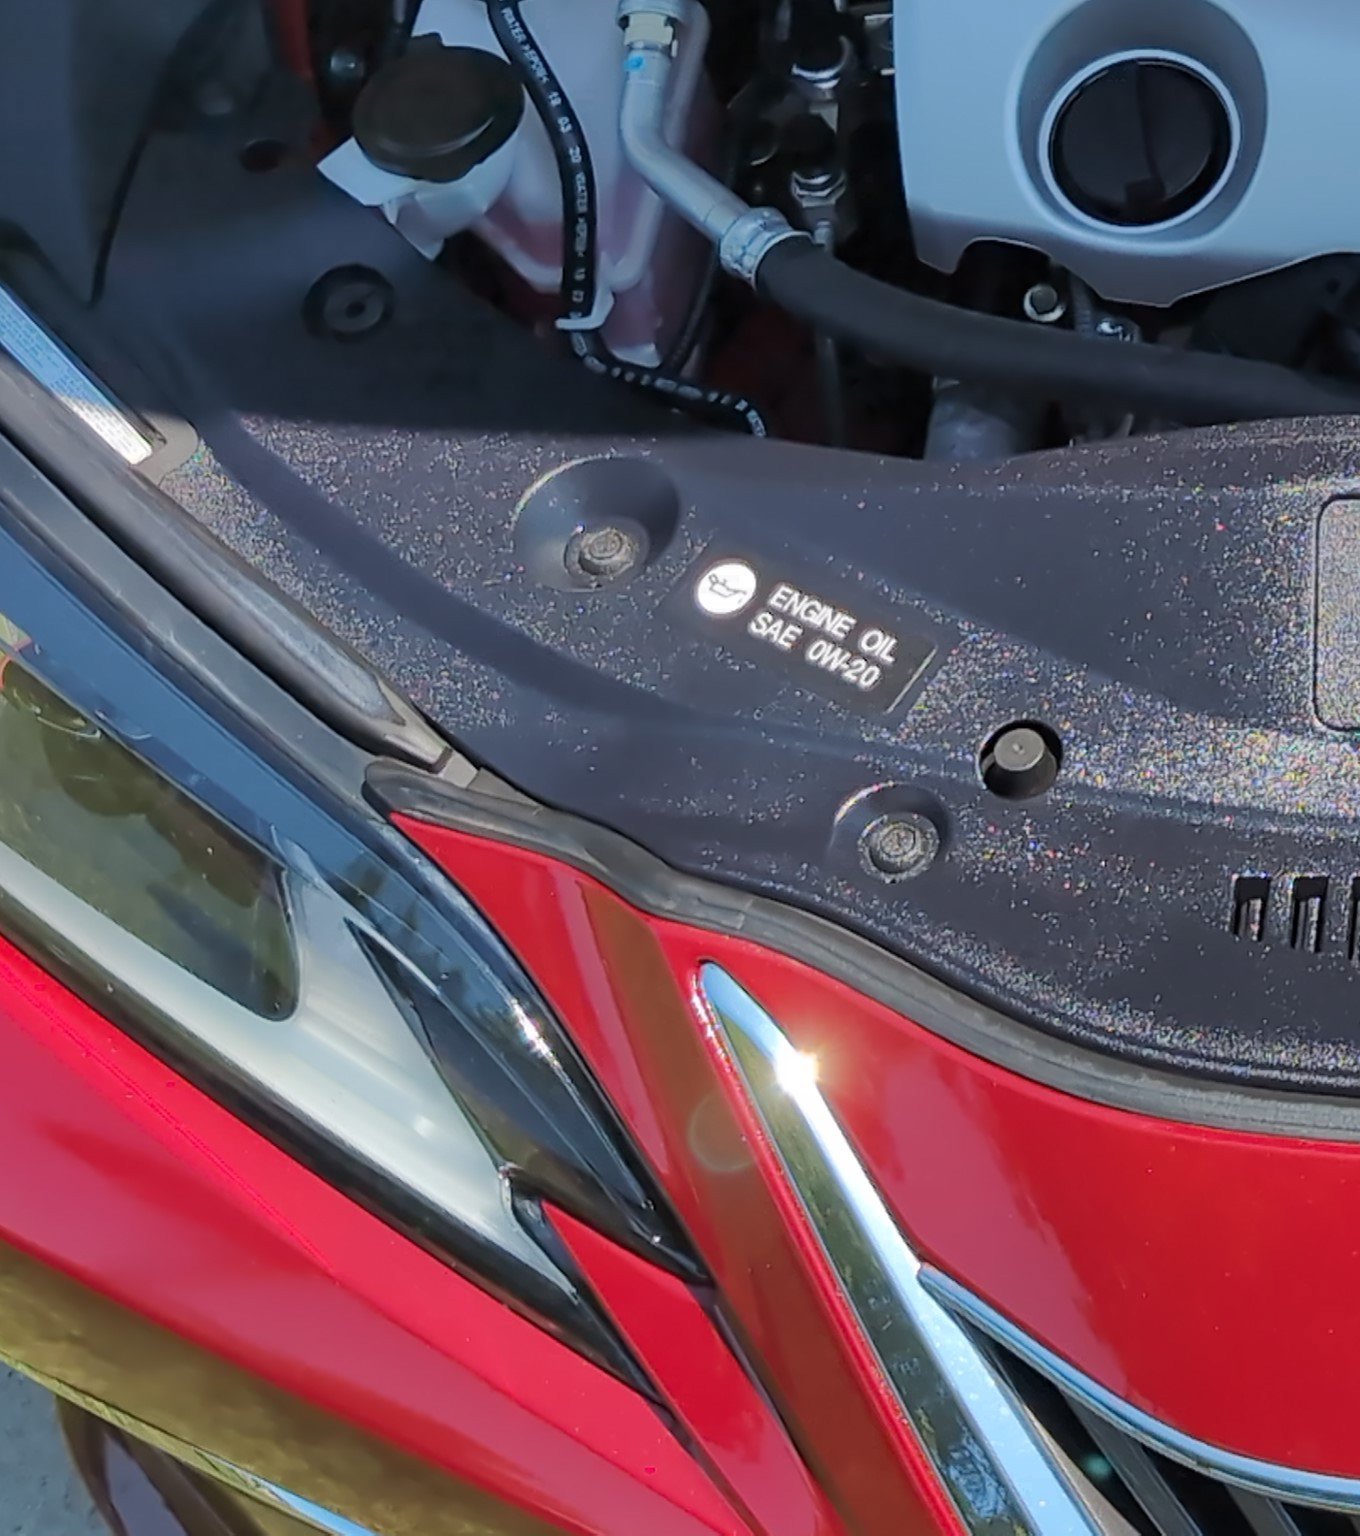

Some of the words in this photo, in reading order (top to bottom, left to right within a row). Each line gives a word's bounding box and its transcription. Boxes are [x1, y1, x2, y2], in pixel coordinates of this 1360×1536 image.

[748, 611, 803, 651] SAE
[805, 638, 882, 690] 0W-20
[768, 583, 856, 640] ENGINE
[858, 627, 899, 664] OIL
